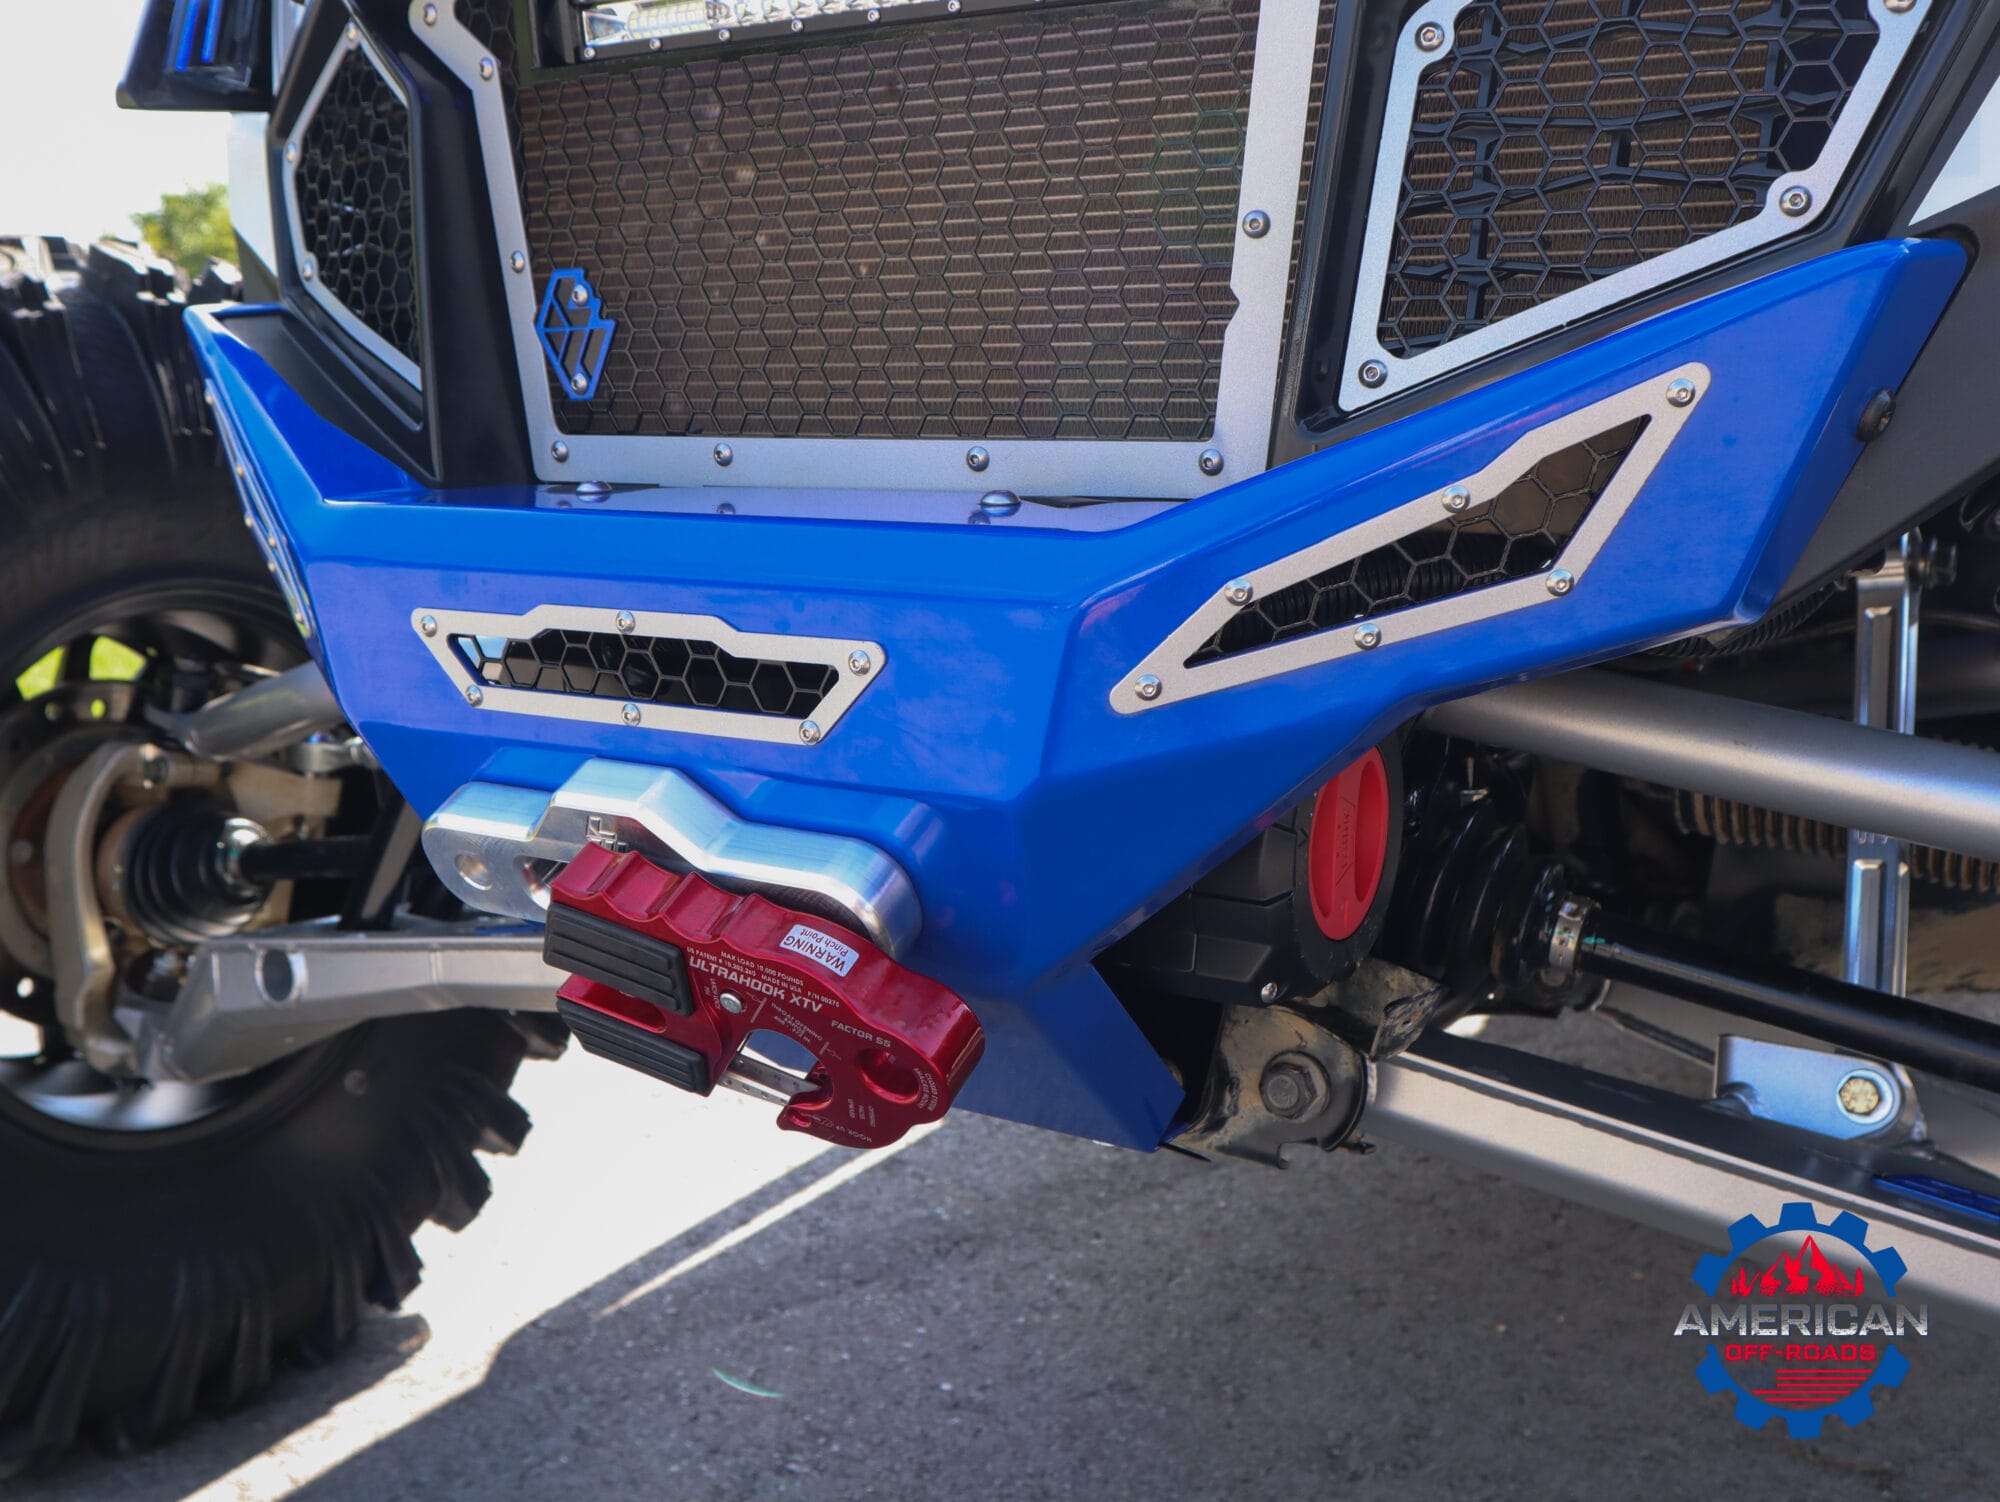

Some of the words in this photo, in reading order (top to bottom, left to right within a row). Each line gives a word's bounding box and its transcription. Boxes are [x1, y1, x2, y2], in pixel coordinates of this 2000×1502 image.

[783, 935, 846, 971] WARNING
[799, 928, 824, 946] Point
[821, 938, 848, 957] Pinch
[689, 955, 785, 1000] ULTRAHOOK
[789, 993, 823, 1012] XTV
[695, 948, 717, 961] PATENT
[761, 974, 781, 986] MADE
[781, 980, 789, 988] IN
[789, 984, 802, 993] USA
[720, 951, 736, 961] MAX
[737, 956, 755, 968] LOAD
[778, 971, 804, 986] POUNDS
[831, 1020, 873, 1040] FACTOR
[875, 1036, 891, 1048] 55
